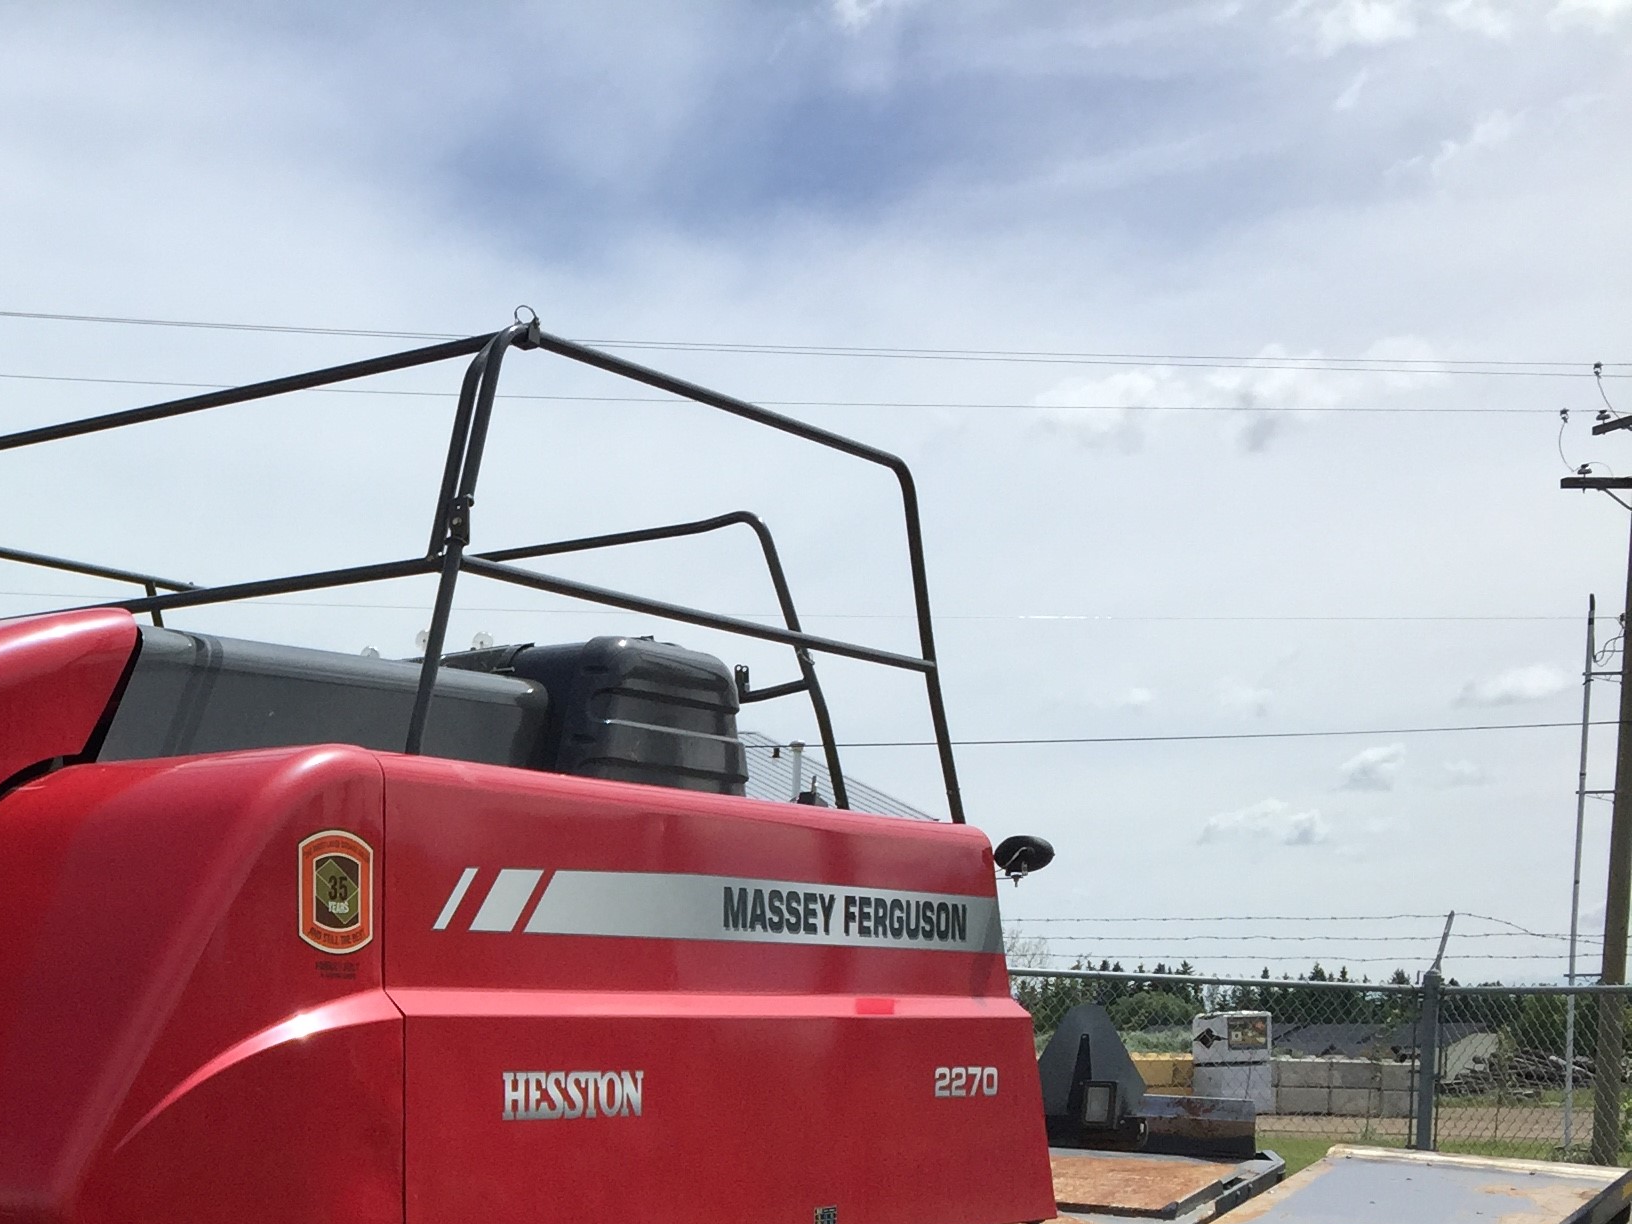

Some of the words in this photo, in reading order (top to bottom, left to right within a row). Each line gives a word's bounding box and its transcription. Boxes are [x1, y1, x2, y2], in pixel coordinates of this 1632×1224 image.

[328, 875, 348, 901] 35
[328, 900, 350, 914] YEARS
[723, 886, 836, 935] MASSEY
[844, 895, 968, 942] FERGUSON
[502, 1070, 644, 1121] HESSTON
[934, 1066, 998, 1098] 2270
